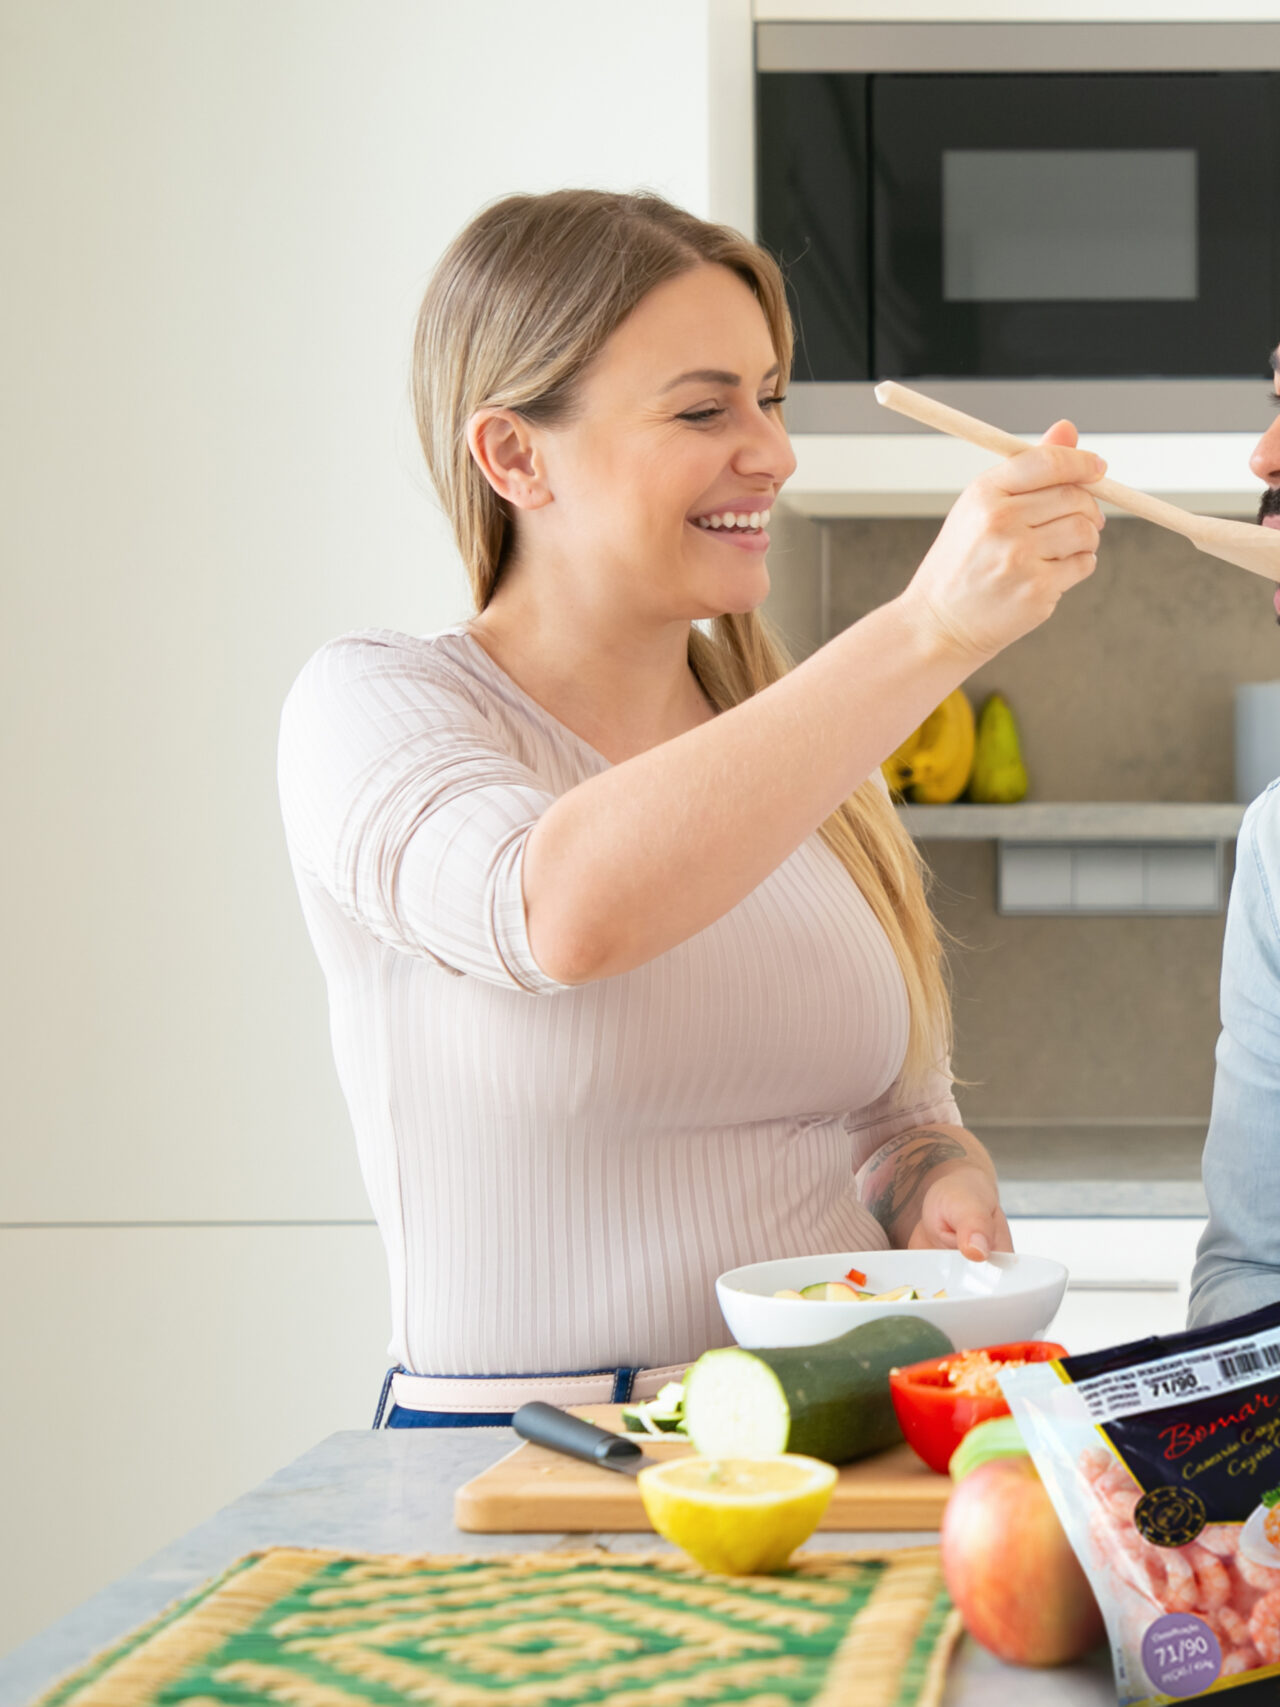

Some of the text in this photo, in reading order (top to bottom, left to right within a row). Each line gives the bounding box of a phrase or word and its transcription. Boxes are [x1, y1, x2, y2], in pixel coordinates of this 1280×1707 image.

[1151, 1373, 1198, 1397] 71/90
[1158, 1393, 1279, 1460] Bomar
[1153, 1636, 1209, 1667] 71/90
